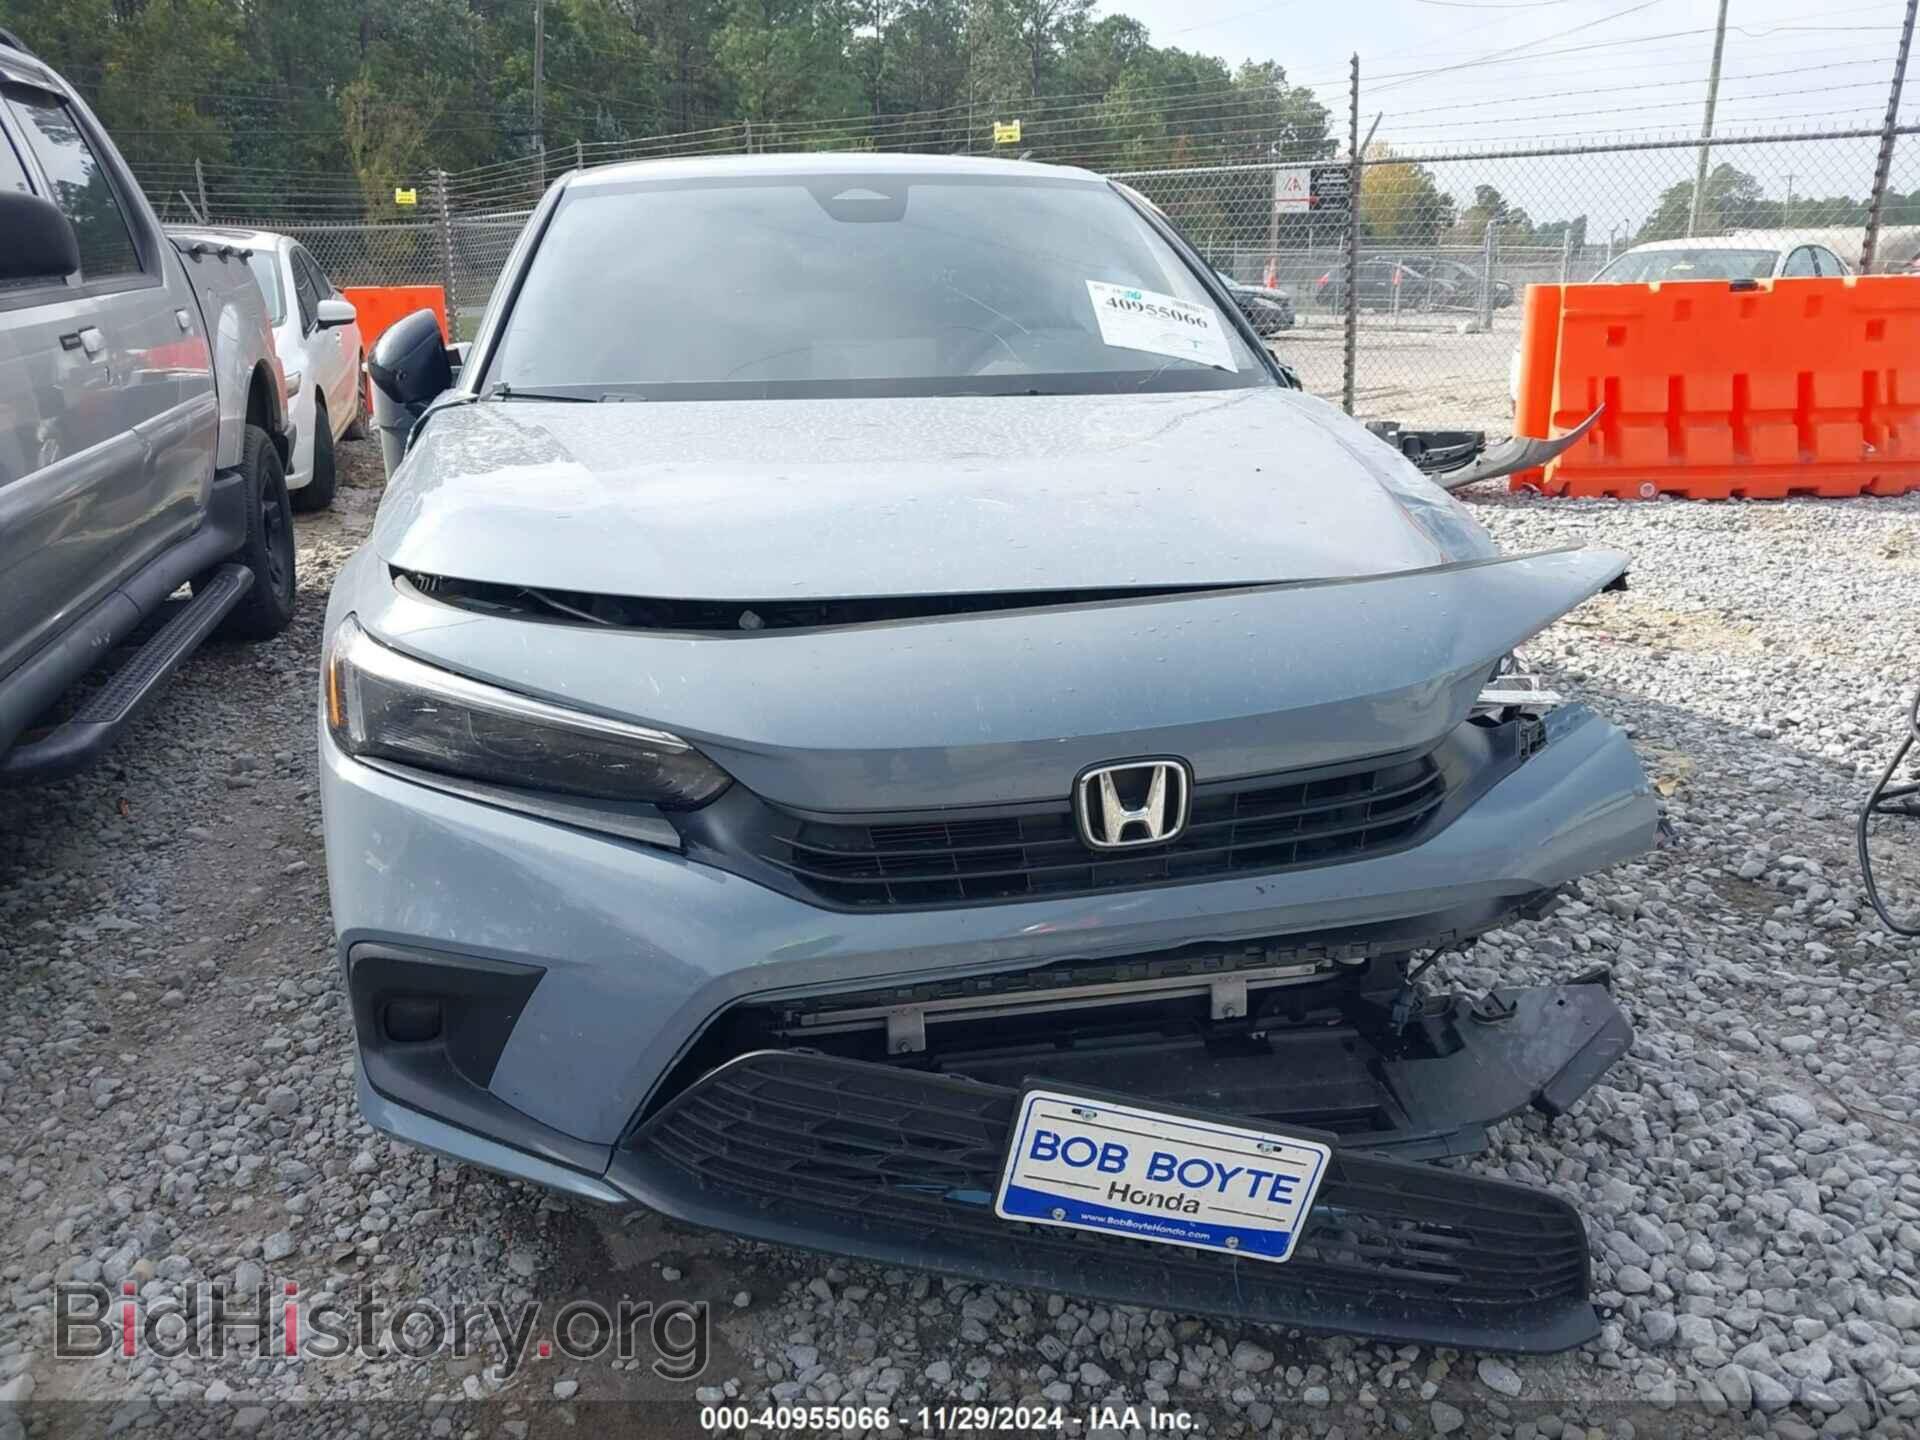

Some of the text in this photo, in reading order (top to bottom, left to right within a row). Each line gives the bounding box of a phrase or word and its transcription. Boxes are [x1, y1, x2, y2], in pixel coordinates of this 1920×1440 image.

[1106, 296, 1208, 329] 40955066
[1029, 1129, 1301, 1205] BOB BOYTE
[1107, 1181, 1201, 1214] Honda
[1080, 1211, 1211, 1241] www.BobBoyteHonda.com
